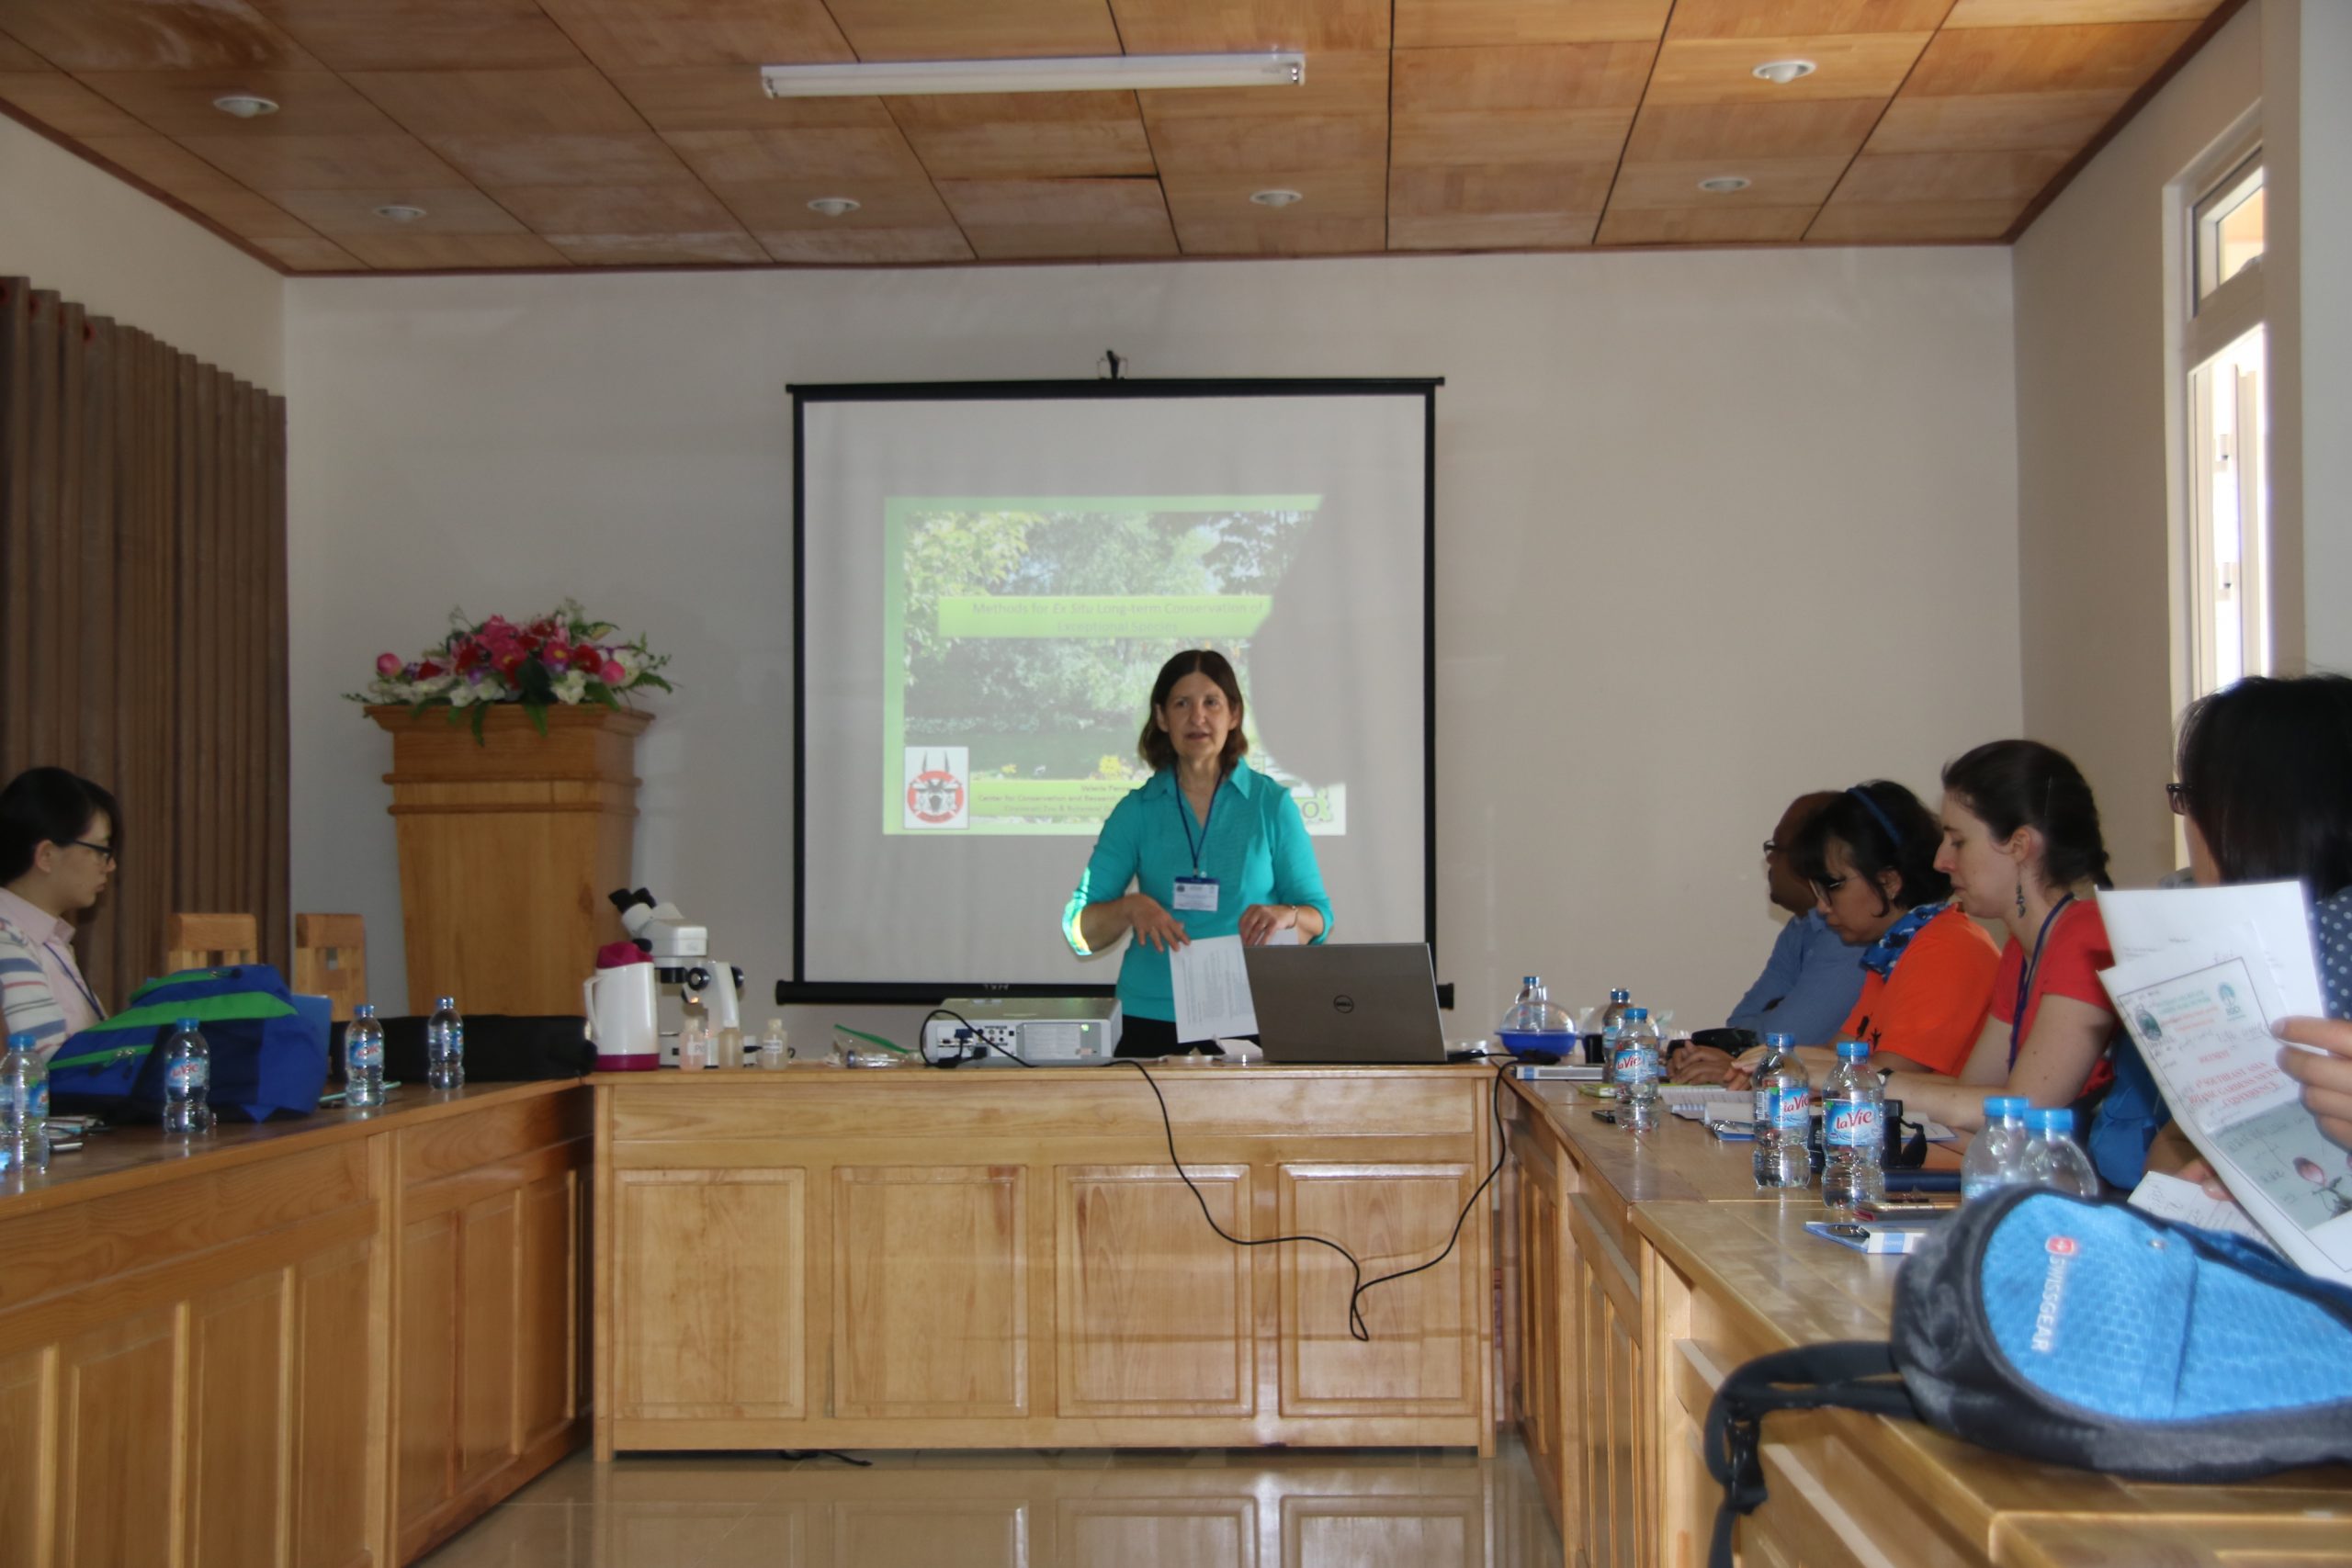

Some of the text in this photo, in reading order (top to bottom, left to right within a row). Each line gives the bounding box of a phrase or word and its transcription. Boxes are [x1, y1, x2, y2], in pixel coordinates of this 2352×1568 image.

[972, 601, 1263, 617] Methods for Ex Situ Long-term Conservation of
[1057, 620, 1178, 635] Exceptional Species
[2031, 1254, 2066, 1351] SWISSGEAR
